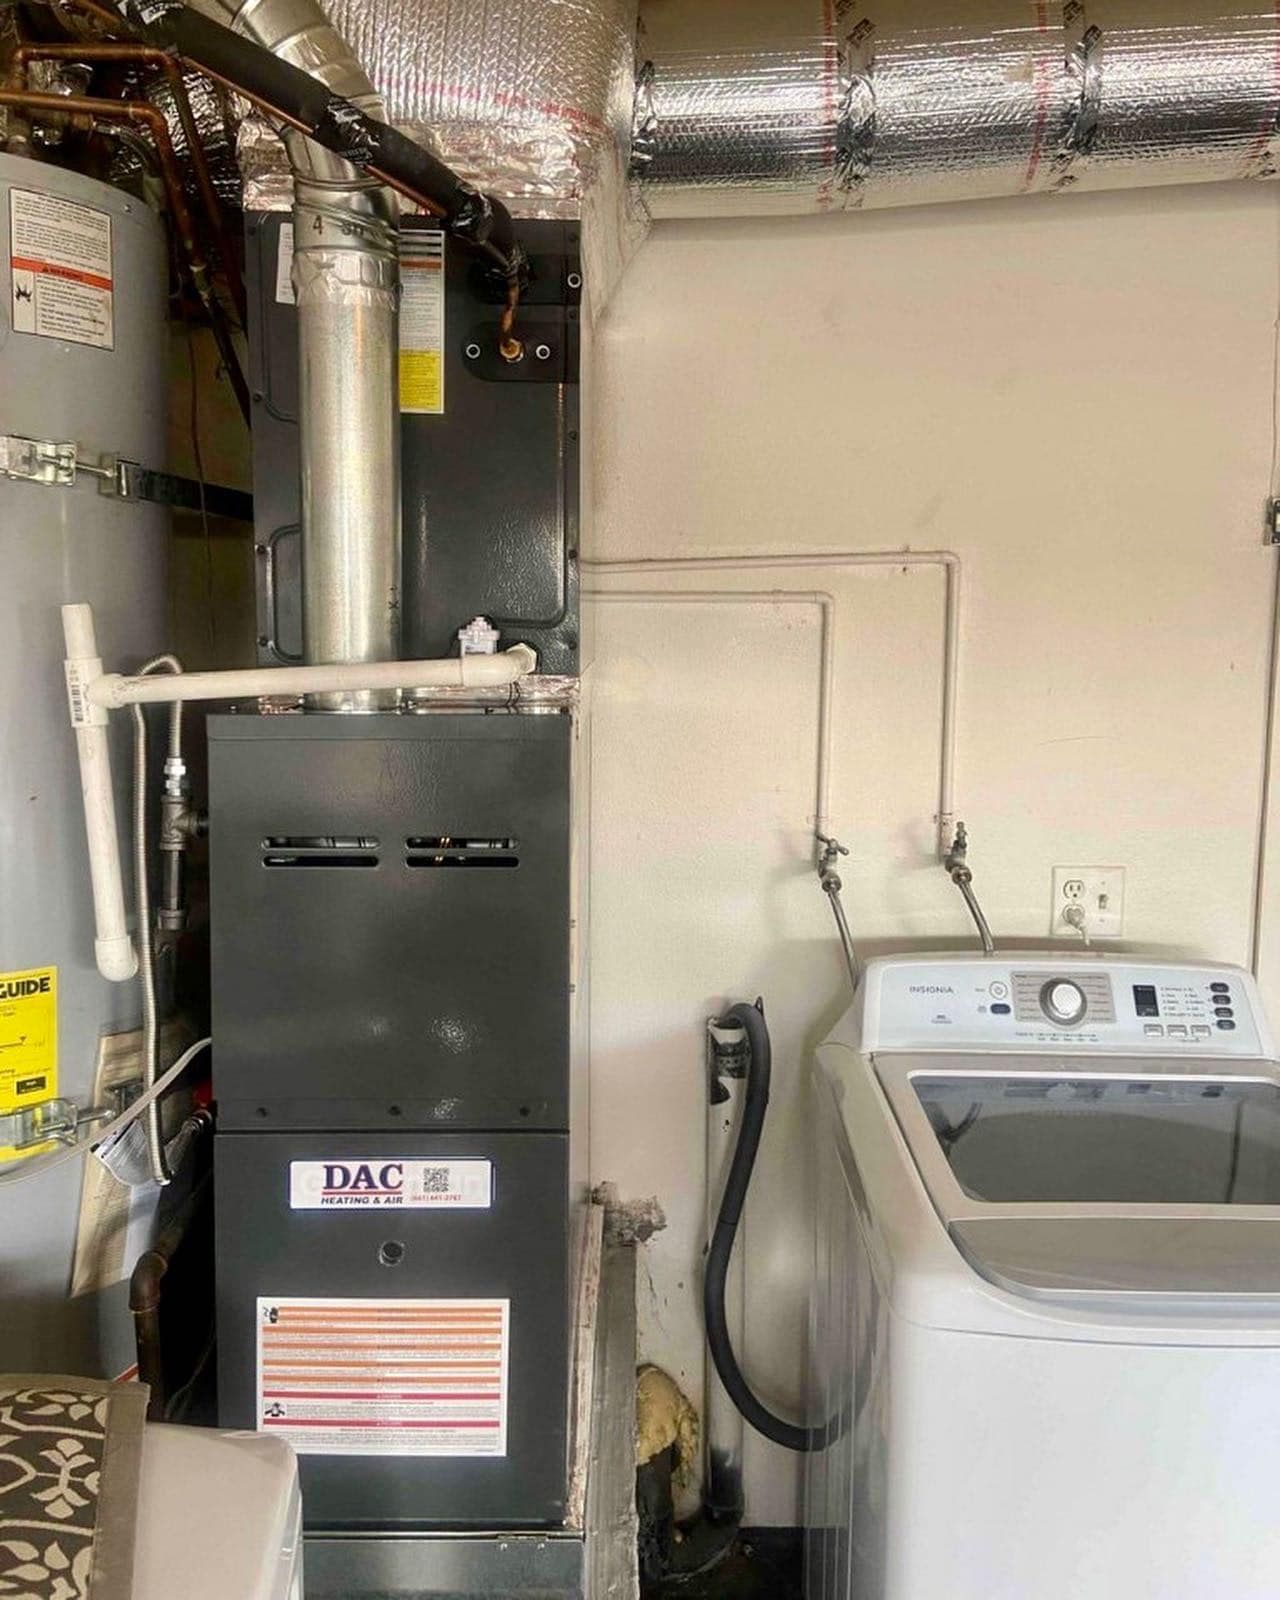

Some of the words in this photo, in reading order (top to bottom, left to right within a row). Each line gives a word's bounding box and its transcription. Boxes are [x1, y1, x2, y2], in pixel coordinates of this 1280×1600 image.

[909, 985, 954, 995] INSIGNIA
[323, 1163, 404, 1190] DAC
[321, 1196, 370, 1205] HEATING
[373, 1196, 381, 1205] &
[384, 1196, 404, 1205] AIR
